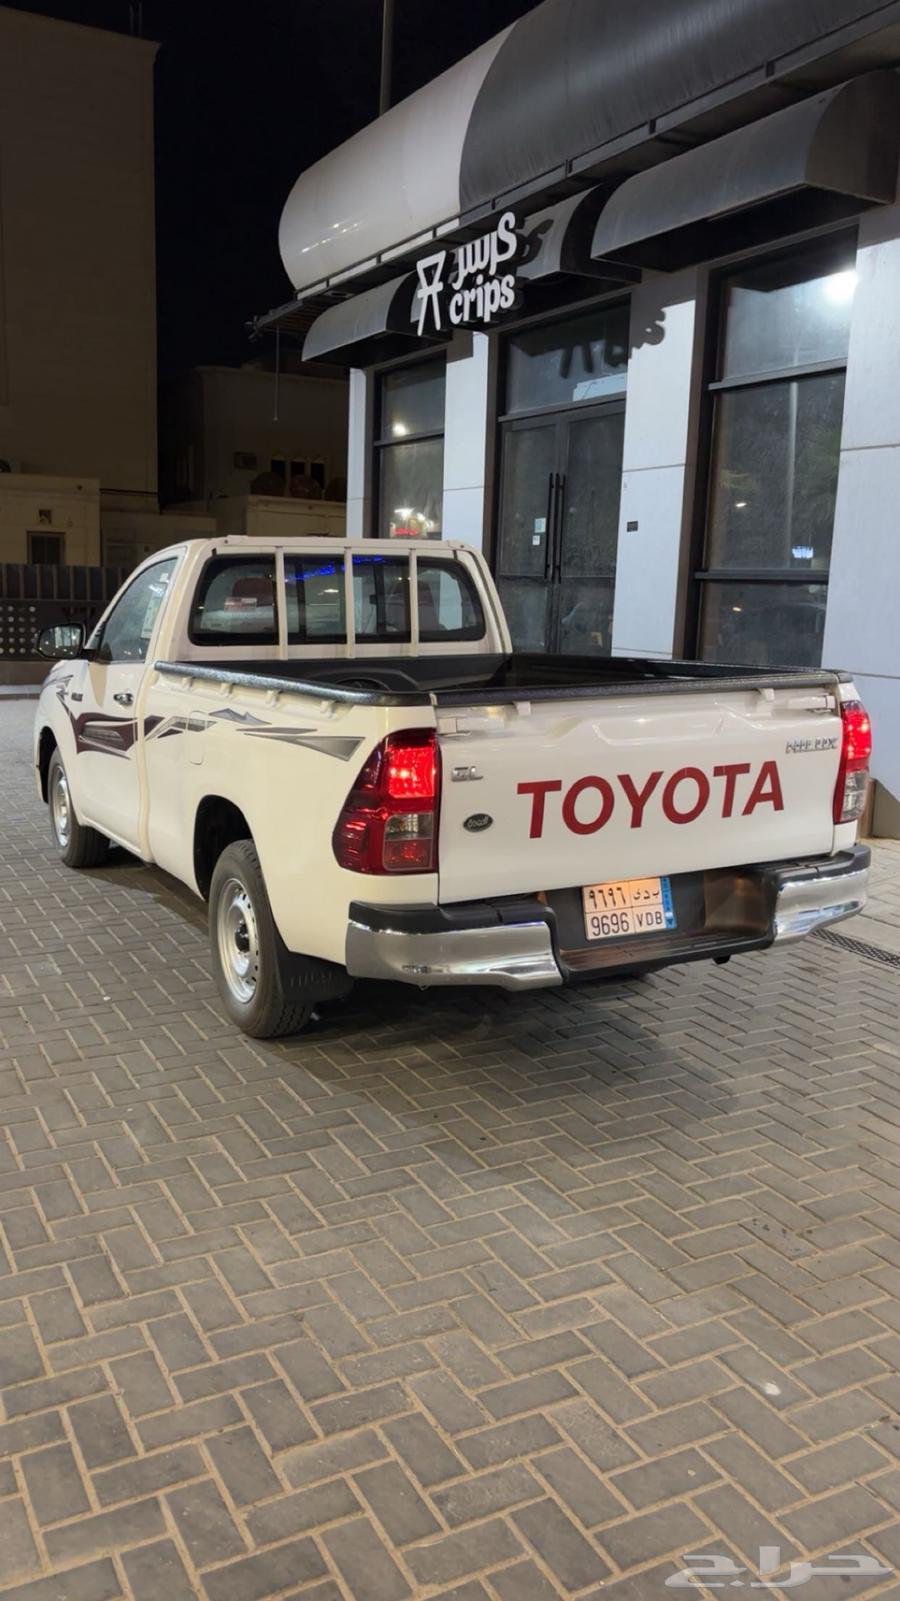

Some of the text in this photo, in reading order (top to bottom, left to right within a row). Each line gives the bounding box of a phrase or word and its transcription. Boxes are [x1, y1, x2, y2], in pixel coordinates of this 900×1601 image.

[449, 274, 515, 325] crips
[517, 760, 784, 839] TOYOTA
[591, 911, 662, 936] 9696 VDB
